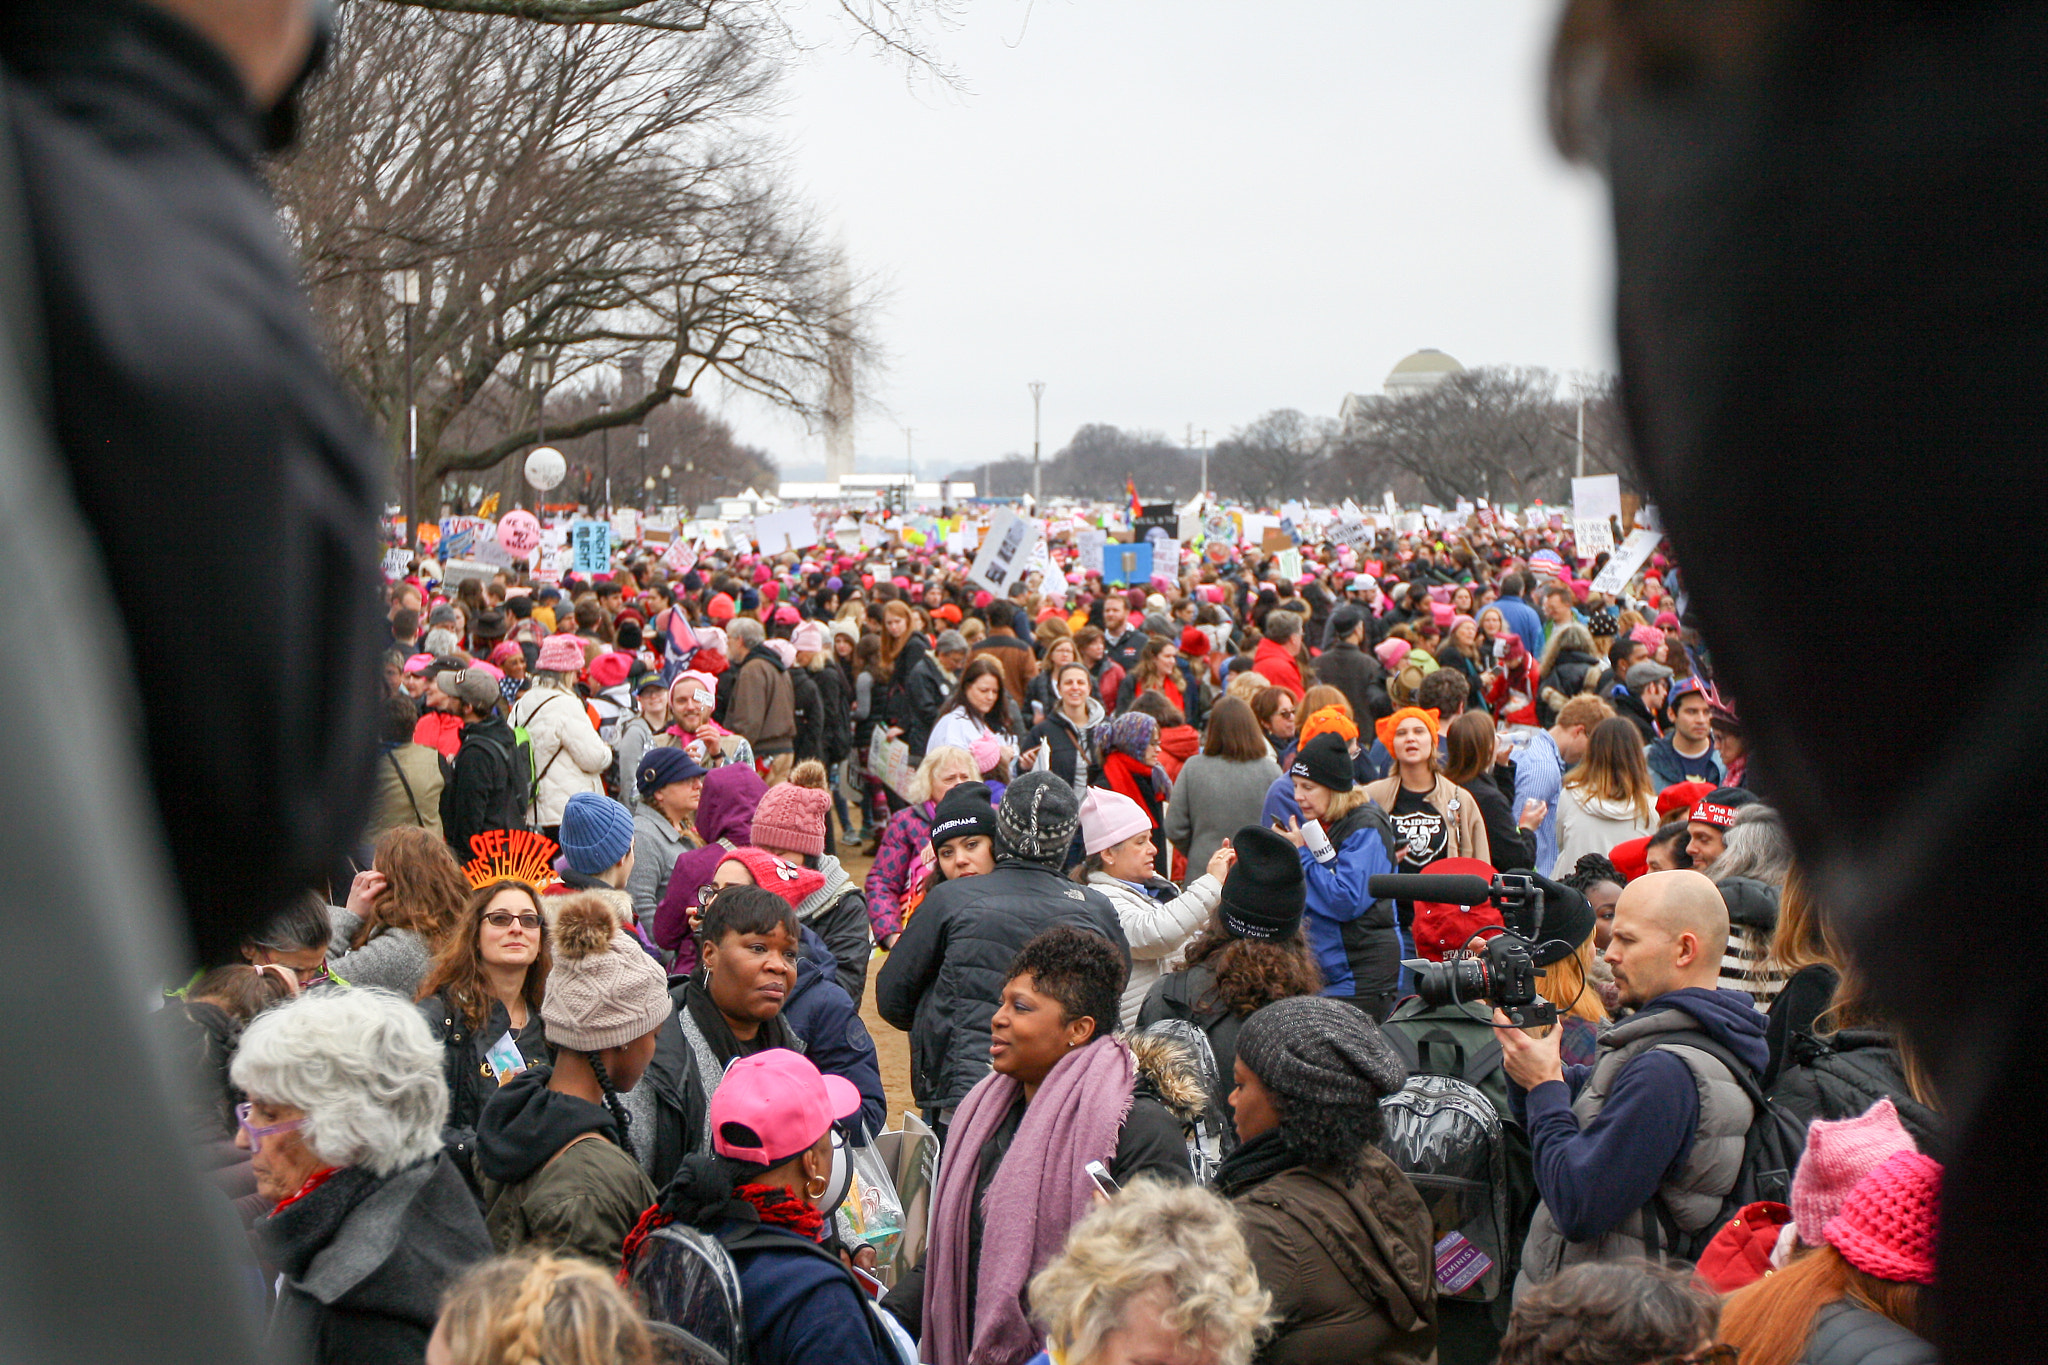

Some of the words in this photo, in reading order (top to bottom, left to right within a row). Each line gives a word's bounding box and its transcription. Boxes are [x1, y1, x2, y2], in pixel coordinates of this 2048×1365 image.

[595, 526, 607, 571] RIGHTS
[1708, 804, 1726, 815] One
[1396, 818, 1441, 826] RAIDERS
[461, 858, 493, 890] HIS
[494, 850, 560, 896] THUMBS
[1247, 930, 1271, 938] FORUM
[1439, 1248, 1475, 1280] FEMINIST
